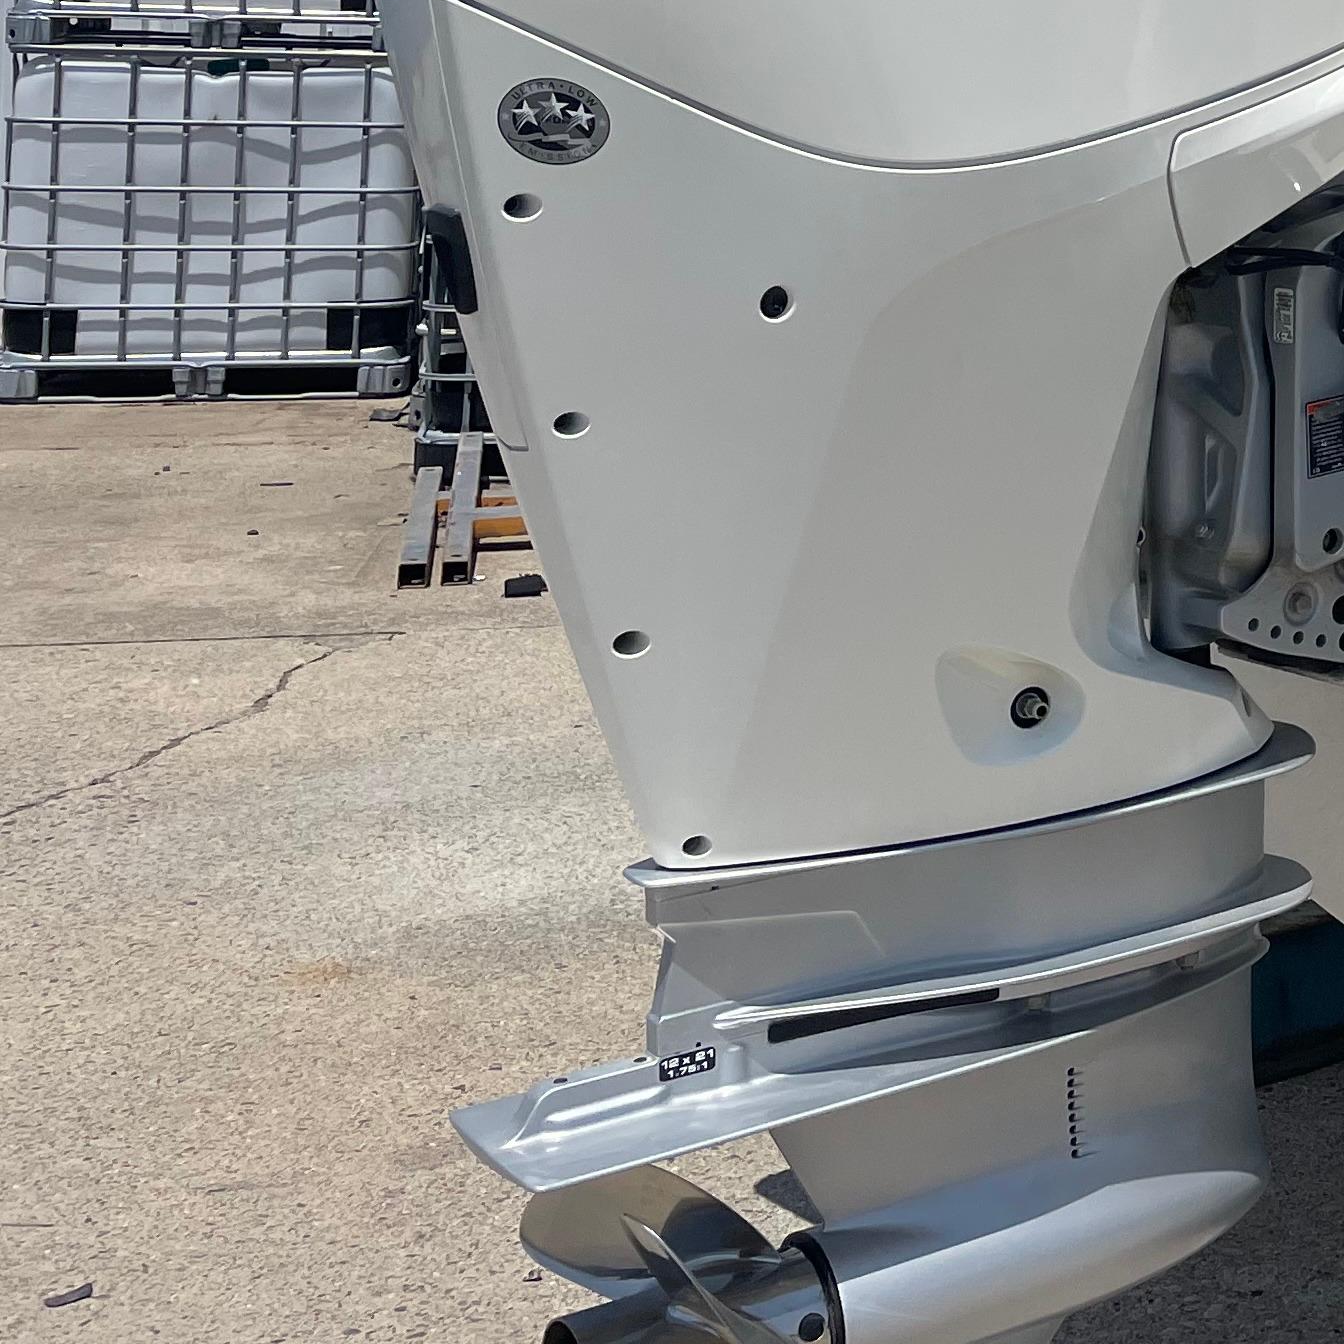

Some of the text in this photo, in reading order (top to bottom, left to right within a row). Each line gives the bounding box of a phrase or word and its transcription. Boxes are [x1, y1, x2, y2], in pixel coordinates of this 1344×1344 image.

[512, 82, 598, 107] ULTRA LOW
[661, 1048, 714, 1070] 12 x 21
